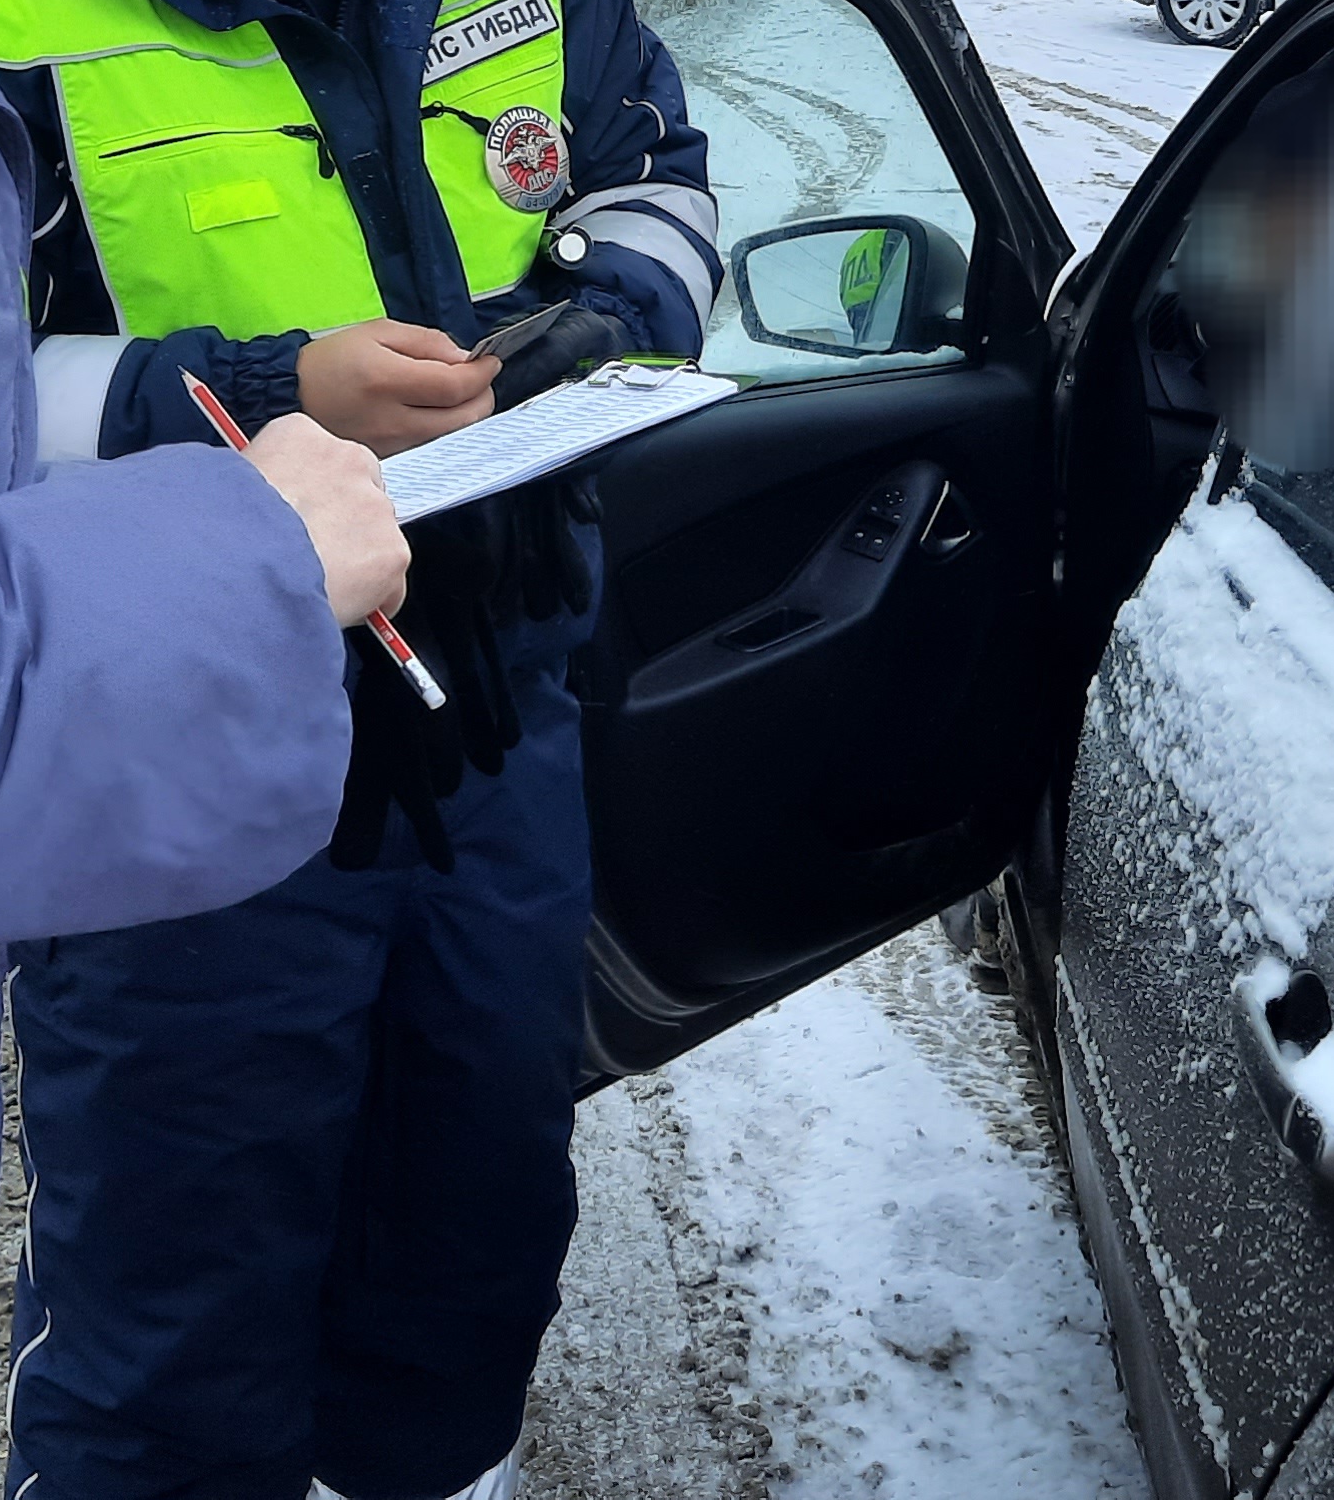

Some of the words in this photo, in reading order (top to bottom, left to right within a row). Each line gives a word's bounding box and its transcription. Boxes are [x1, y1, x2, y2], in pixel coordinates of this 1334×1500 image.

[425, 35, 460, 74] ПС
[490, 108, 548, 149] ПОЛИЦИЯ
[527, 167, 555, 192] ДПС
